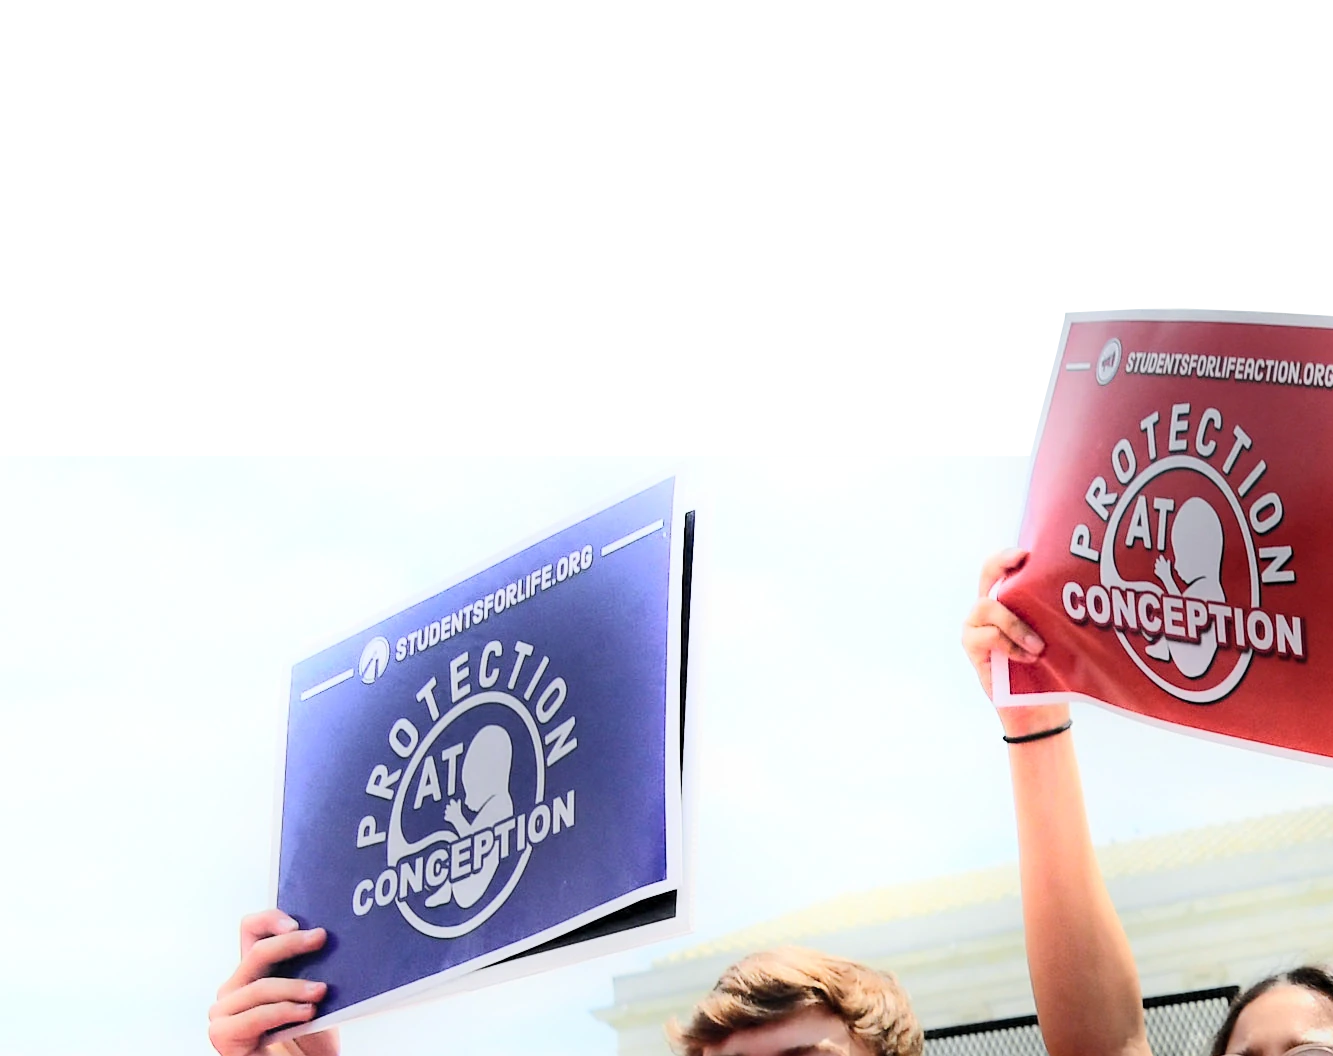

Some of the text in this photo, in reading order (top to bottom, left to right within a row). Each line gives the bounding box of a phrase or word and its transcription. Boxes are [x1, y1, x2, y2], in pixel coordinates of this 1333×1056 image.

[1070, 402, 1297, 585] PROTECTION
[1125, 494, 1175, 552] AT
[396, 544, 594, 662] STUDENTSFORLIFE.ORG
[1061, 580, 1306, 659] CONCEPTION
[355, 640, 579, 850] PROTECTION
[413, 743, 465, 810] AT
[352, 789, 576, 917] CONCEPTION
